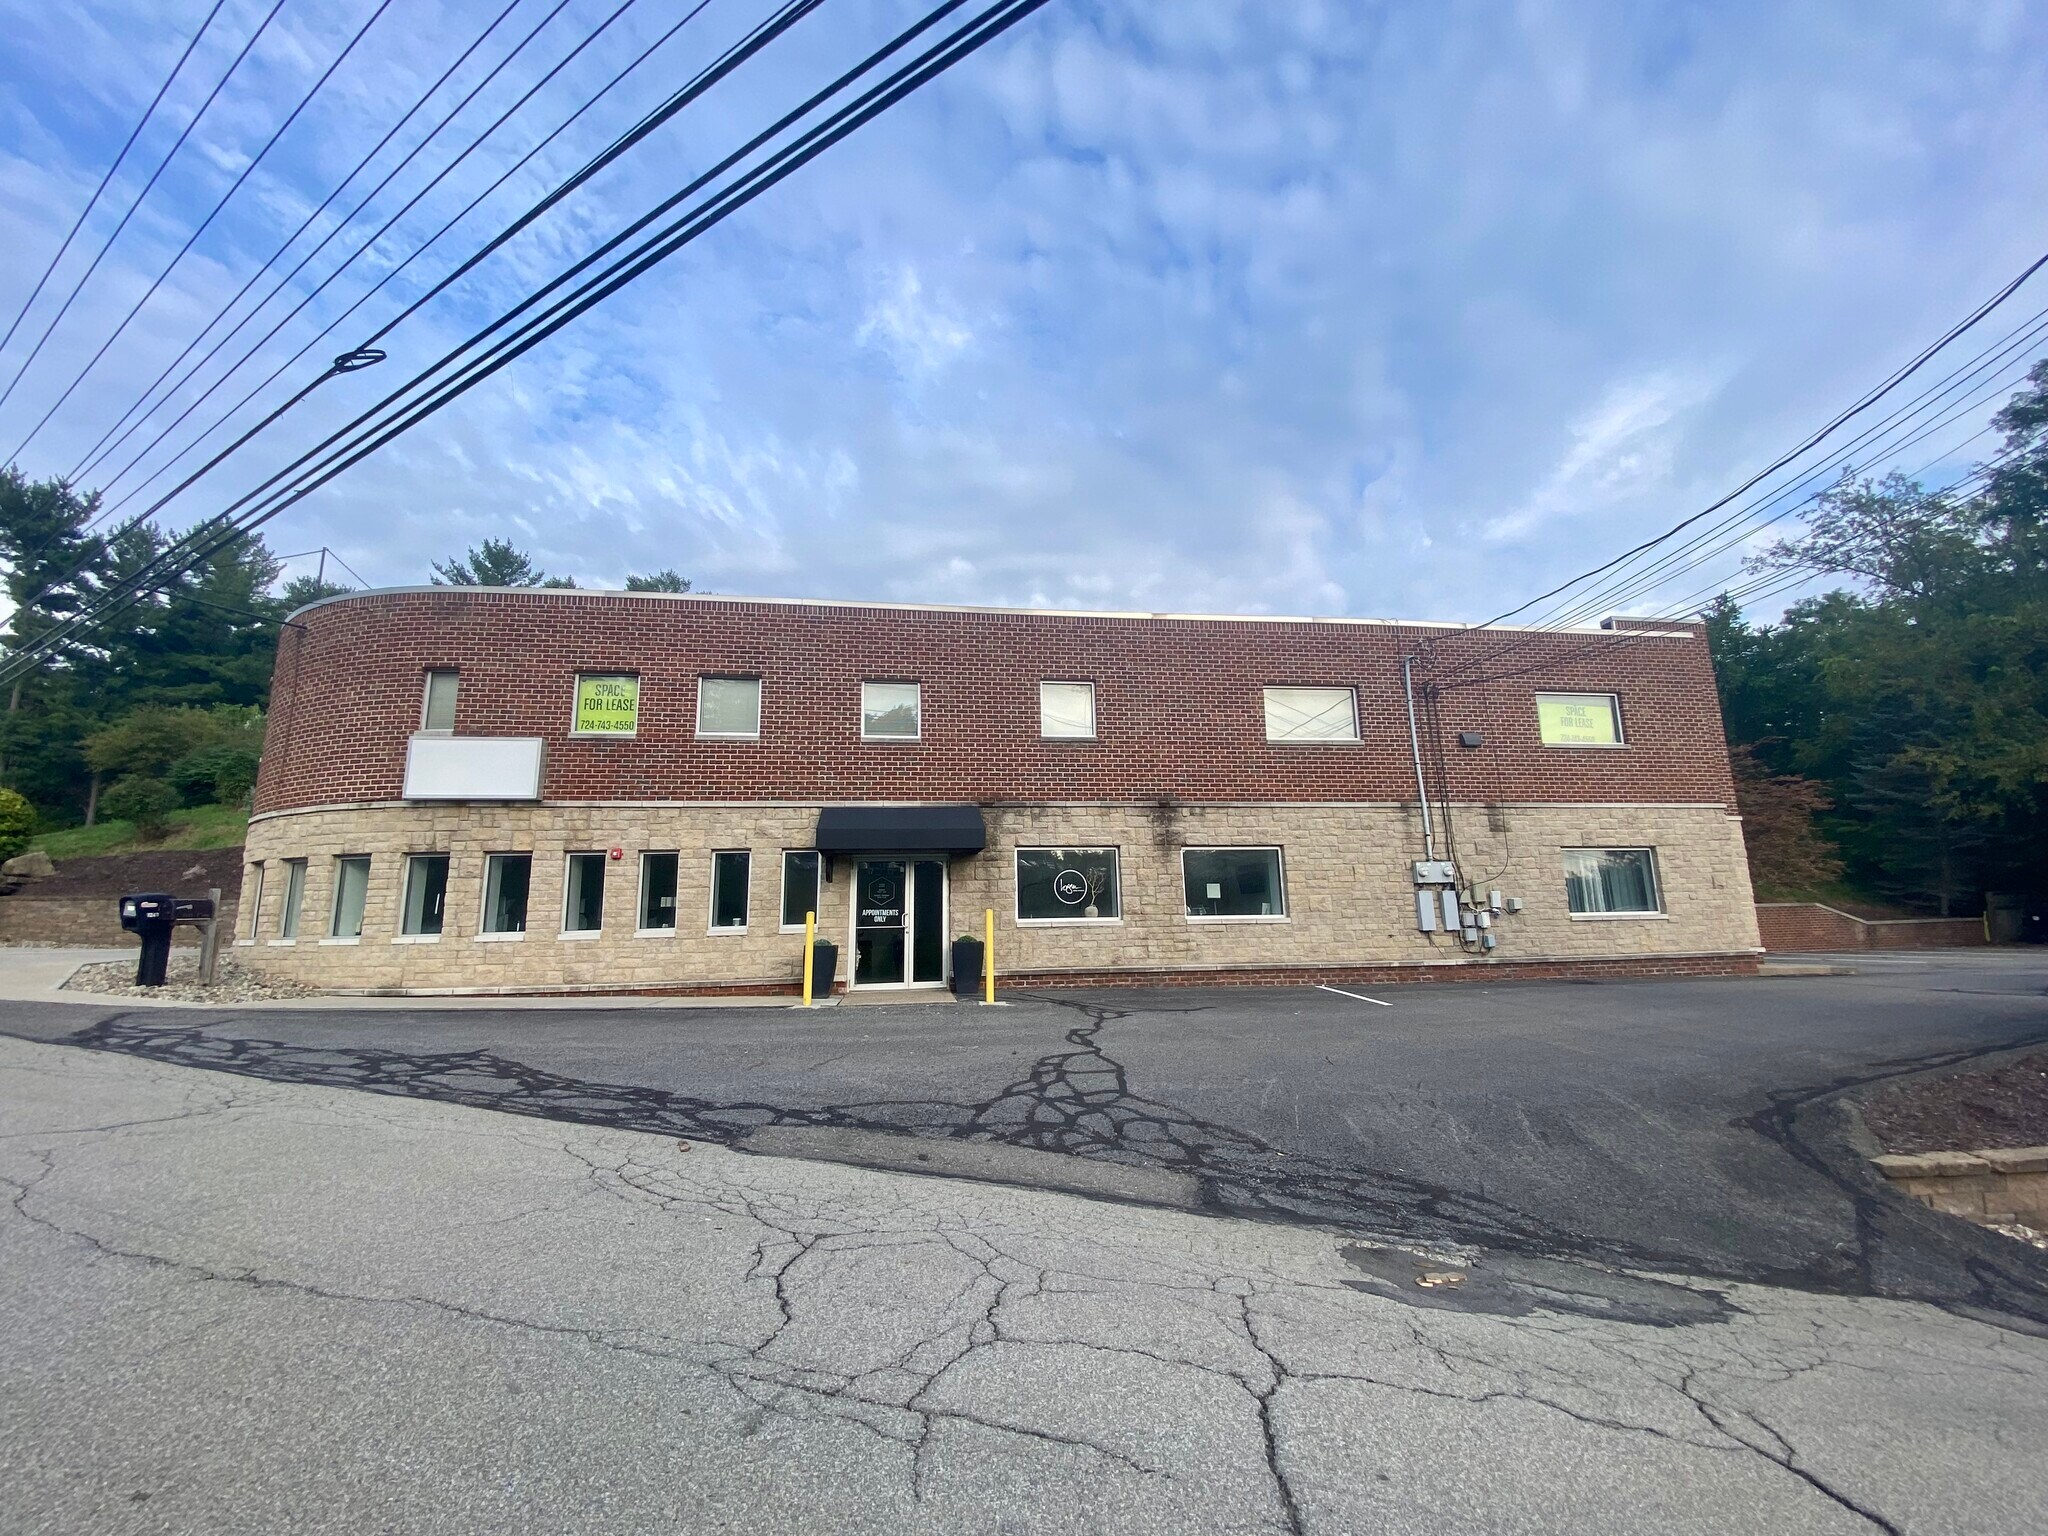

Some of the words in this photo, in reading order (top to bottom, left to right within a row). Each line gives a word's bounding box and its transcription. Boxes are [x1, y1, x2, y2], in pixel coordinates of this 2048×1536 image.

[595, 684, 625, 697] SPACE
[584, 698, 603, 711] FOR
[606, 699, 635, 711] LEASE
[1565, 706, 1587, 717] SPACE
[580, 720, 635, 731] 724-743-4550
[1560, 717, 1574, 727] FOR
[1575, 718, 1594, 728] LEASE
